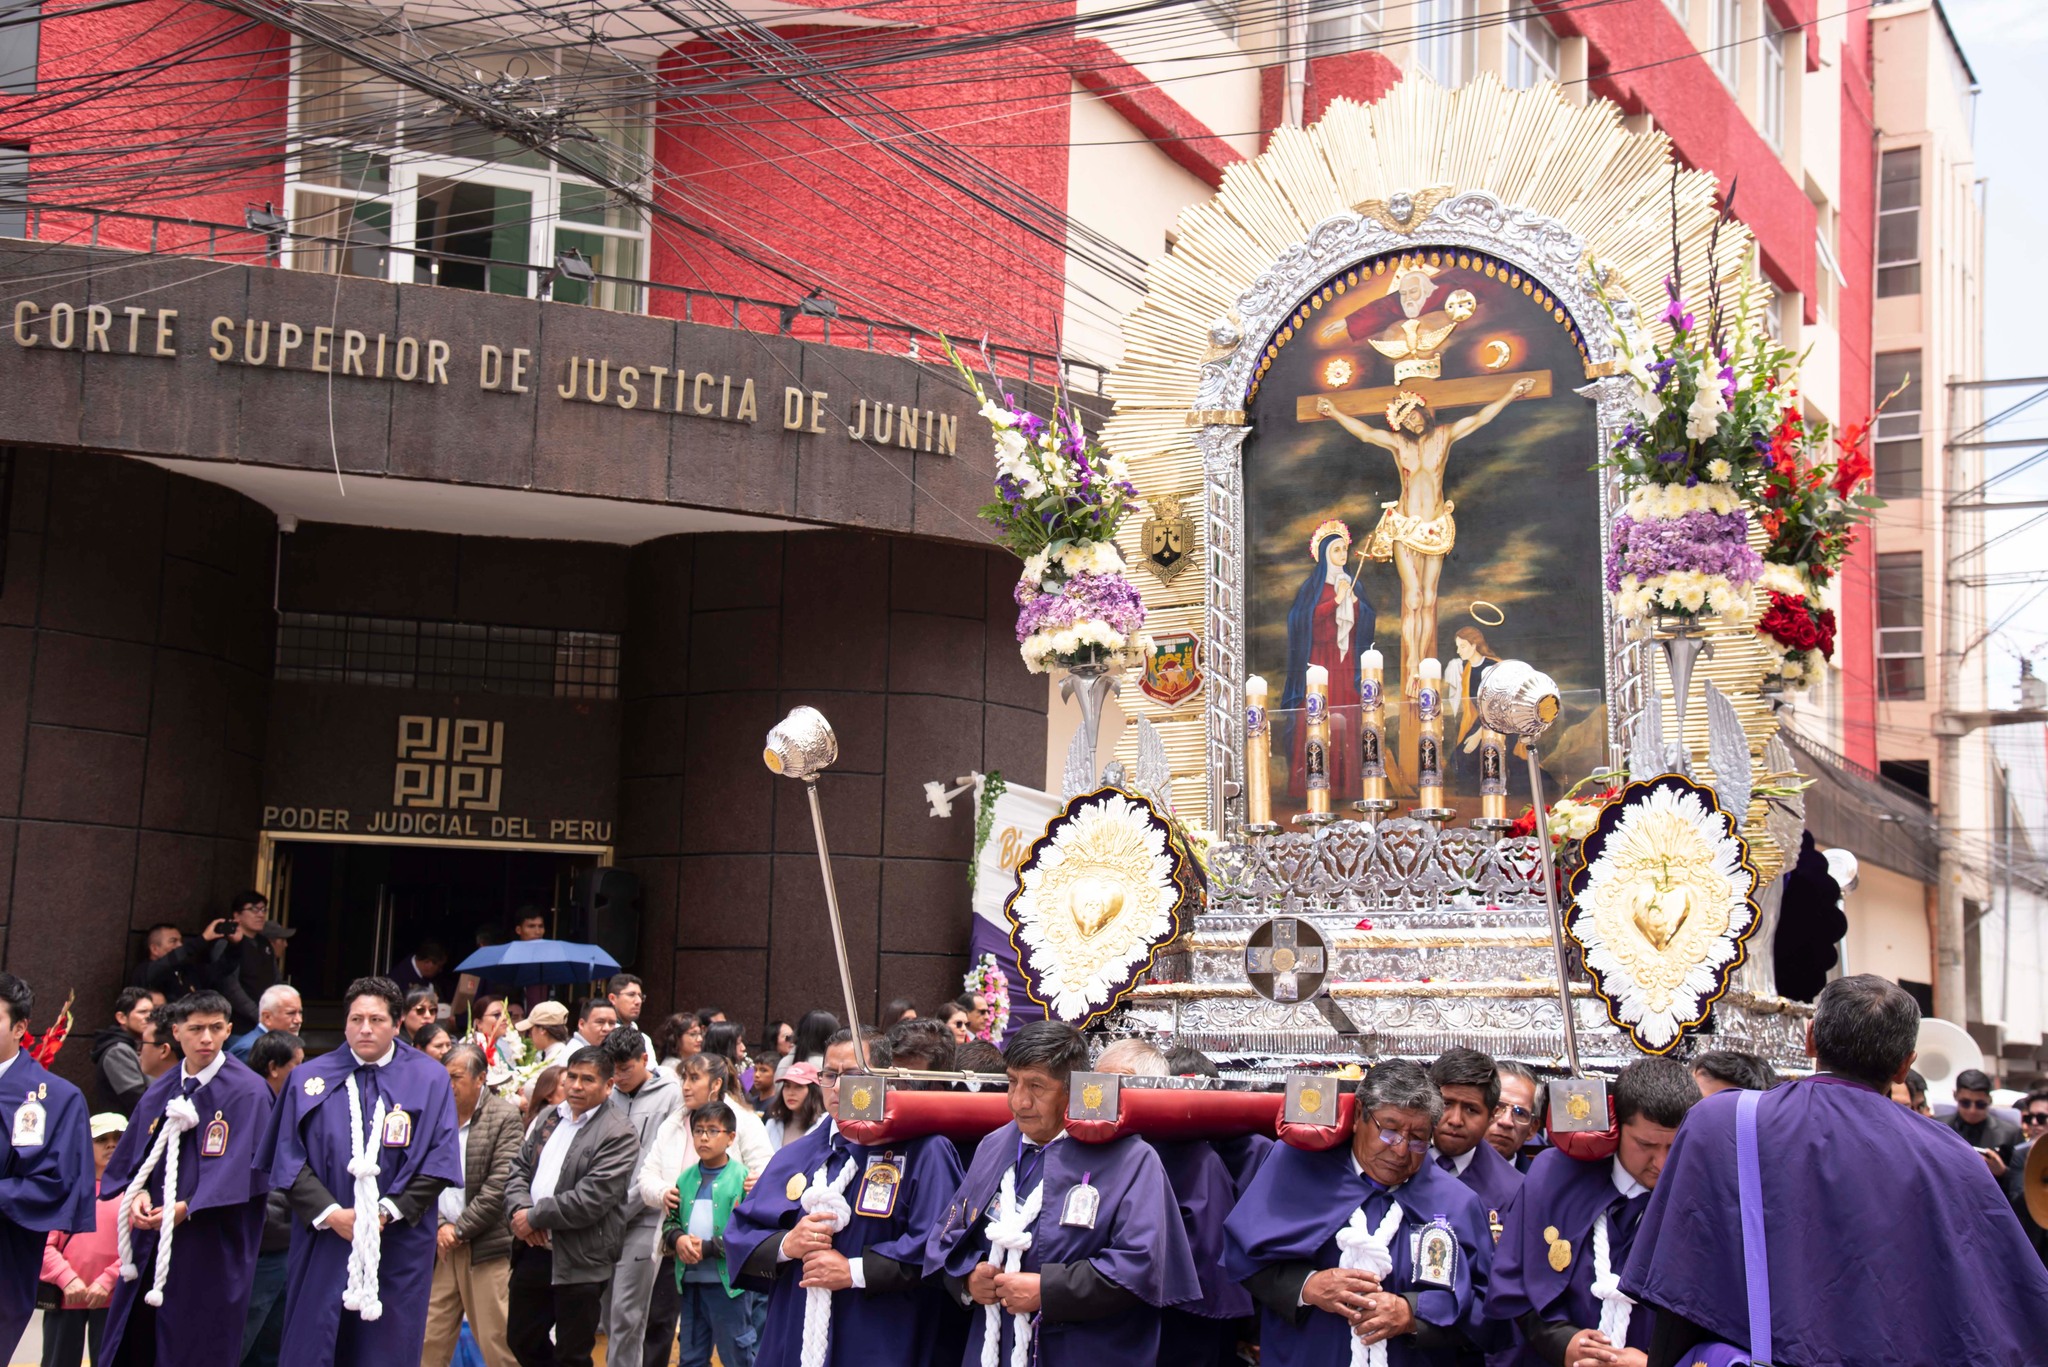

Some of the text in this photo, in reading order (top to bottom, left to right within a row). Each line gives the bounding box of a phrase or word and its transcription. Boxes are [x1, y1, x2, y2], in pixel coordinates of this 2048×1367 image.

[13, 300, 958, 456] CORTE SUPERIOR DE JUSTICIA DE JUNIN
[263, 805, 612, 842] PODER JUDICIAL DEL PERU
